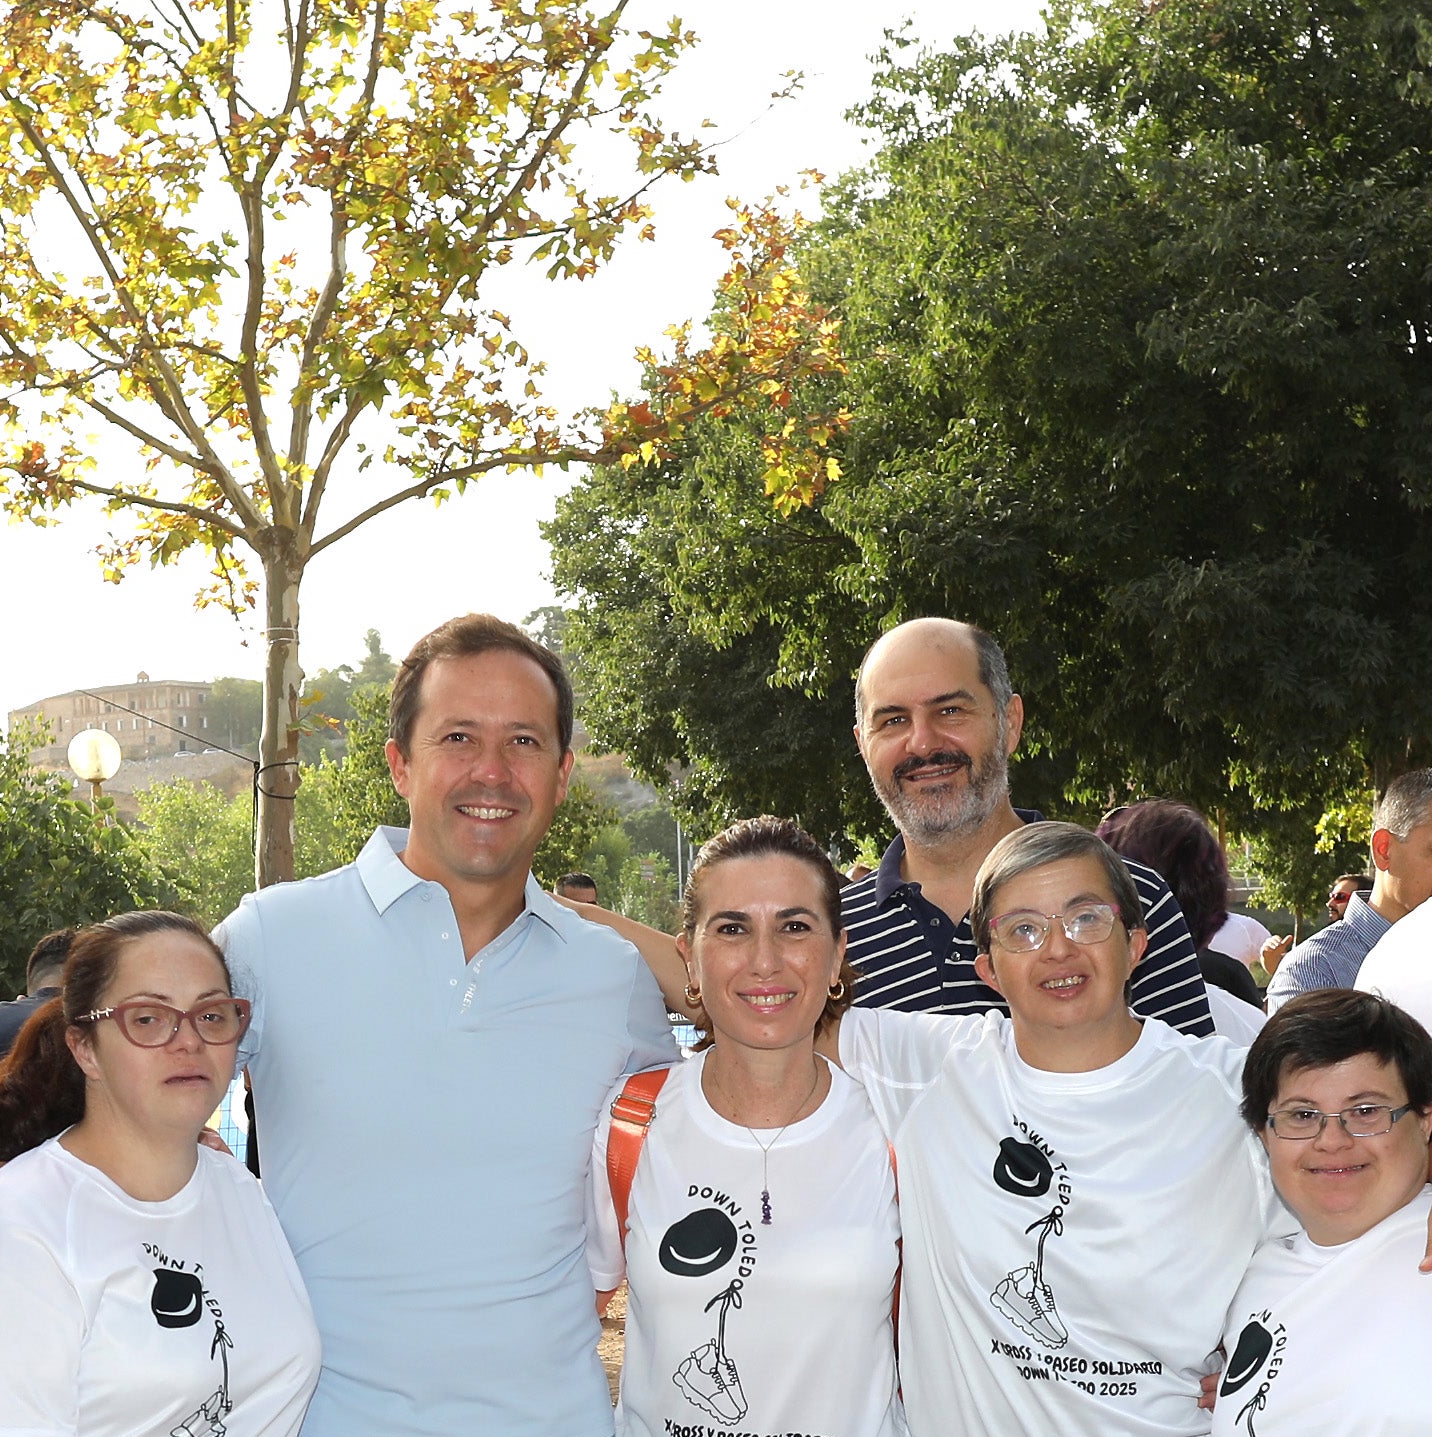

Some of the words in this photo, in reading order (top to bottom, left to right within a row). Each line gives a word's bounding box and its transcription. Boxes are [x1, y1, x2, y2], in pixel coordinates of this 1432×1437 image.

[687, 1184, 742, 1216] DOWN
[730, 1220, 758, 1291] TOLEDO
[142, 1243, 186, 1270] DOWN
[991, 1339, 1001, 1354] X
[1092, 1360, 1163, 1376] SOLIDARIO
[1258, 1322, 1288, 1395] TOLEDO
[1099, 1382, 1138, 1397] 2025
[664, 1418, 673, 1432] X
